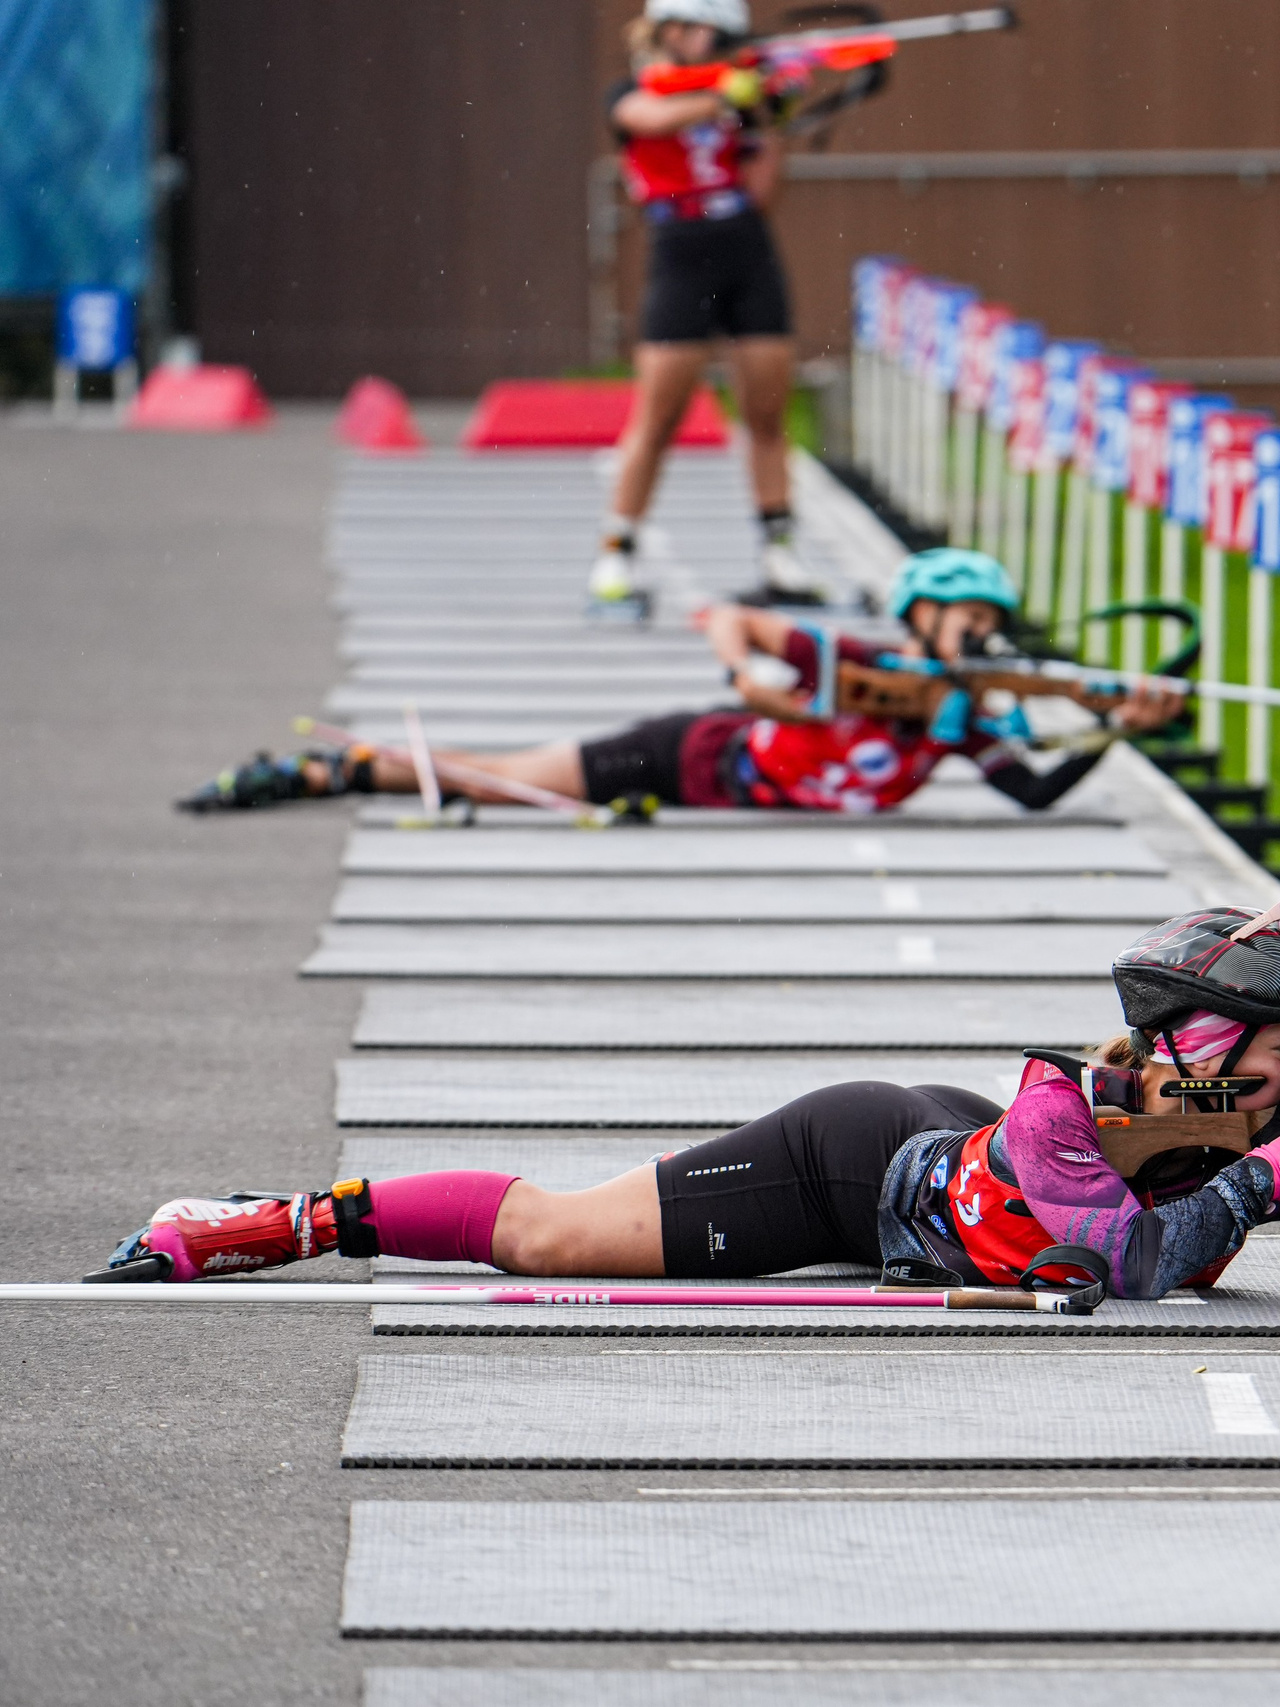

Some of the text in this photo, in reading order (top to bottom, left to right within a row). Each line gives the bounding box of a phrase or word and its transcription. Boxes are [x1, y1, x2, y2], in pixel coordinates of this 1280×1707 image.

[301, 1216, 314, 1260] alpin
[202, 1251, 265, 1270] alpina
[532, 1293, 610, 1304] HIDE
